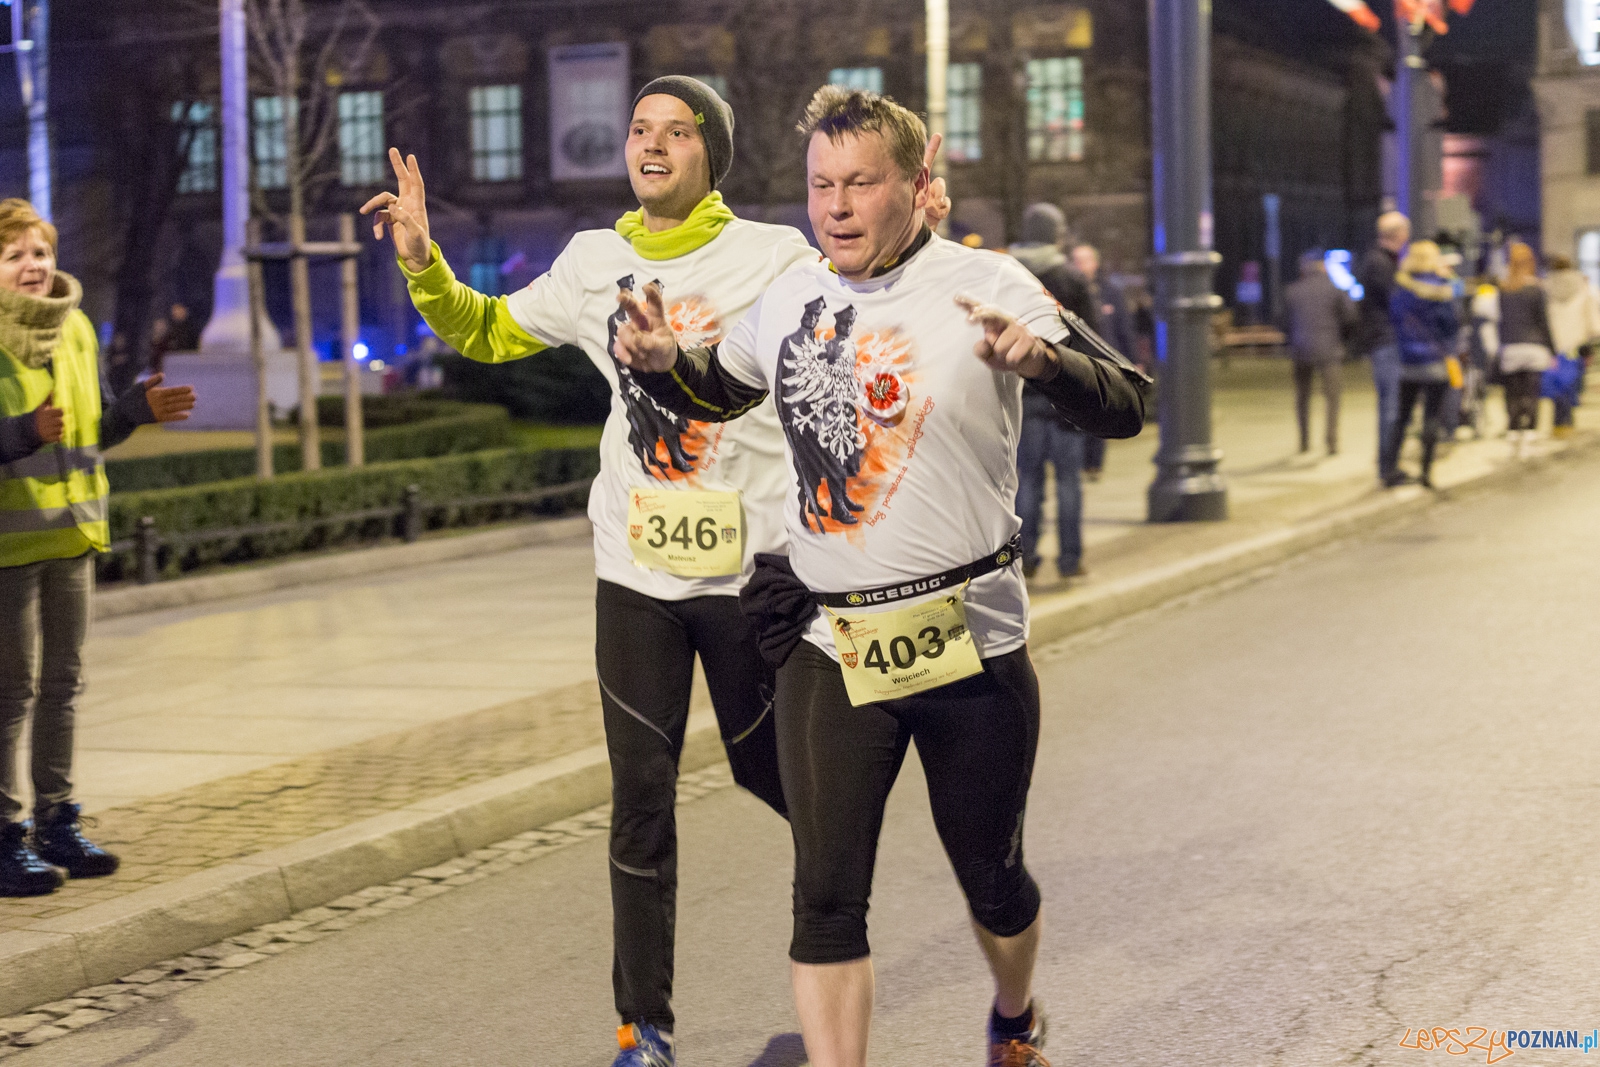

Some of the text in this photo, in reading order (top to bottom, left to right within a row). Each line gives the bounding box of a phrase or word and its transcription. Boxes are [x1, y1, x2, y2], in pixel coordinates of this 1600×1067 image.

[647, 515, 718, 551] 346
[667, 554, 697, 562] Mateusz
[863, 626, 946, 675] 403
[891, 668, 930, 685] Wojciech
